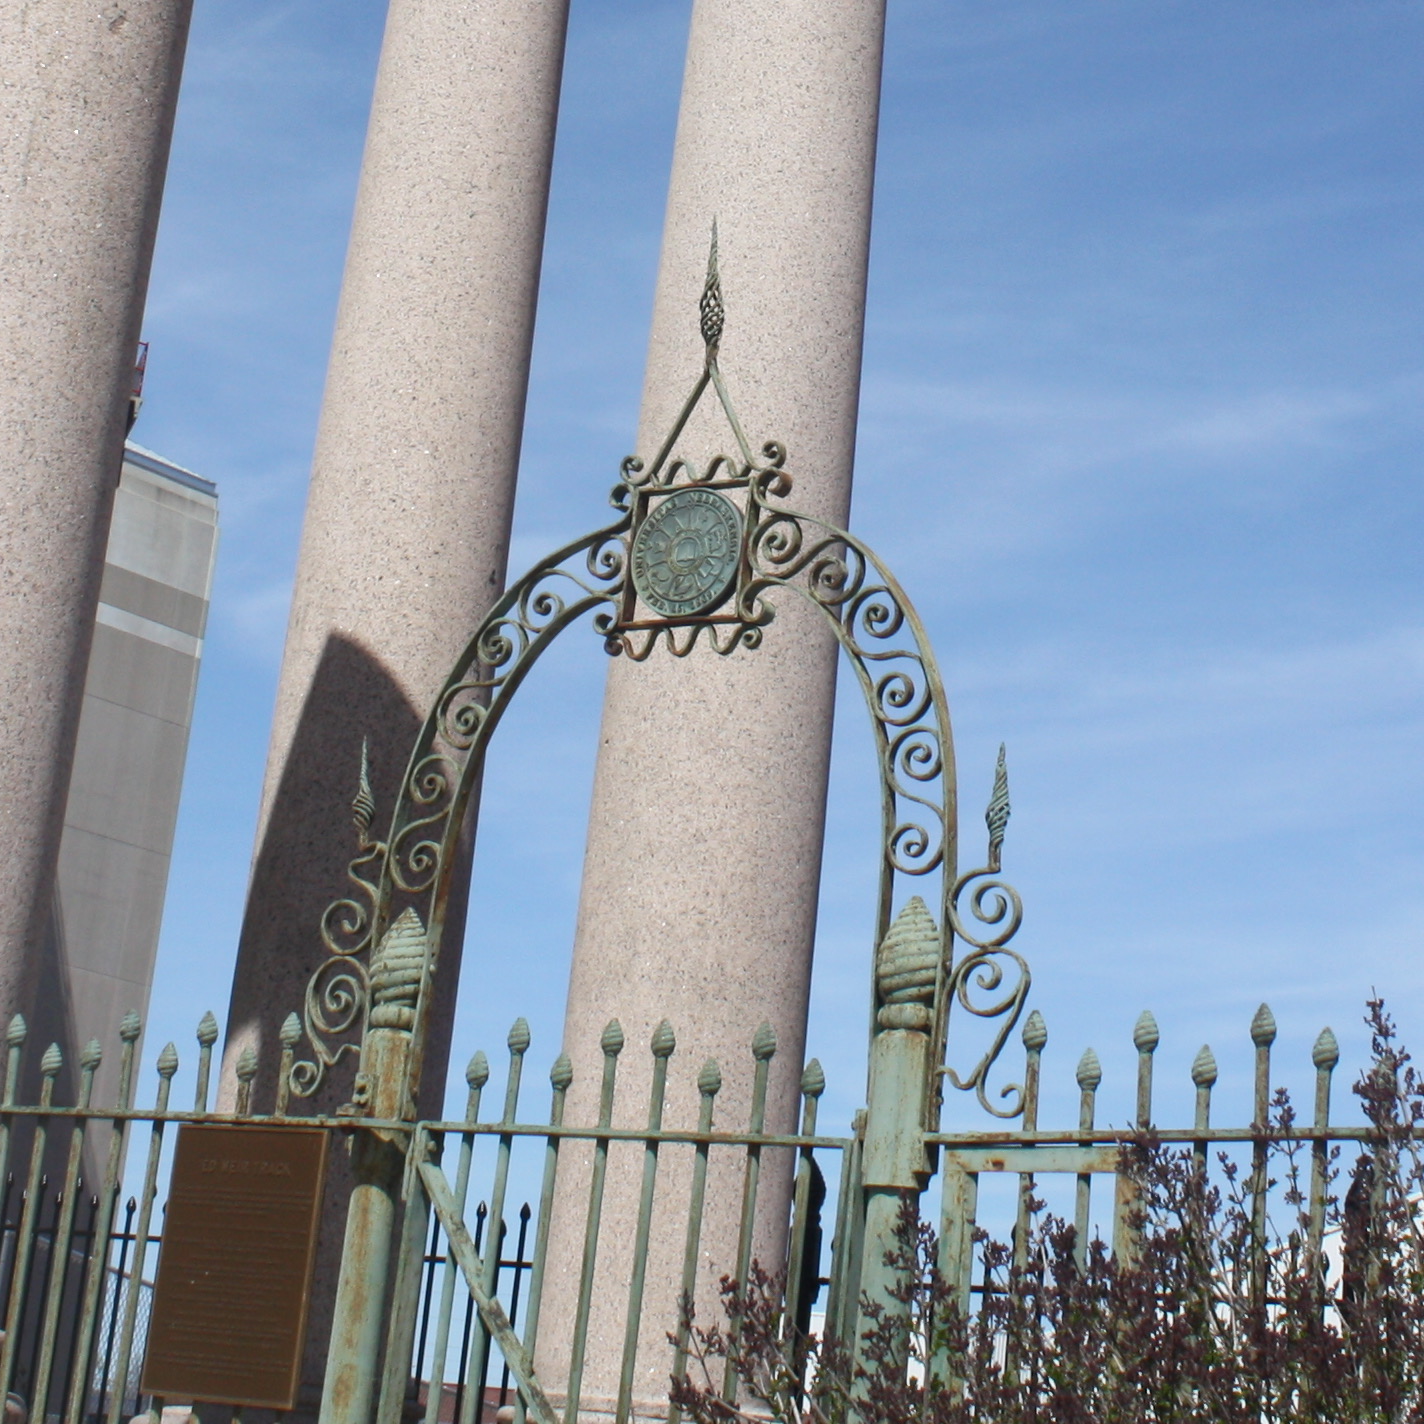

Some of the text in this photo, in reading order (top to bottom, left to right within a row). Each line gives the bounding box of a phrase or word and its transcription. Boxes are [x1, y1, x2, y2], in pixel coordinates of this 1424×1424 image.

[201, 1159, 292, 1177] ED WEIR TRACK
